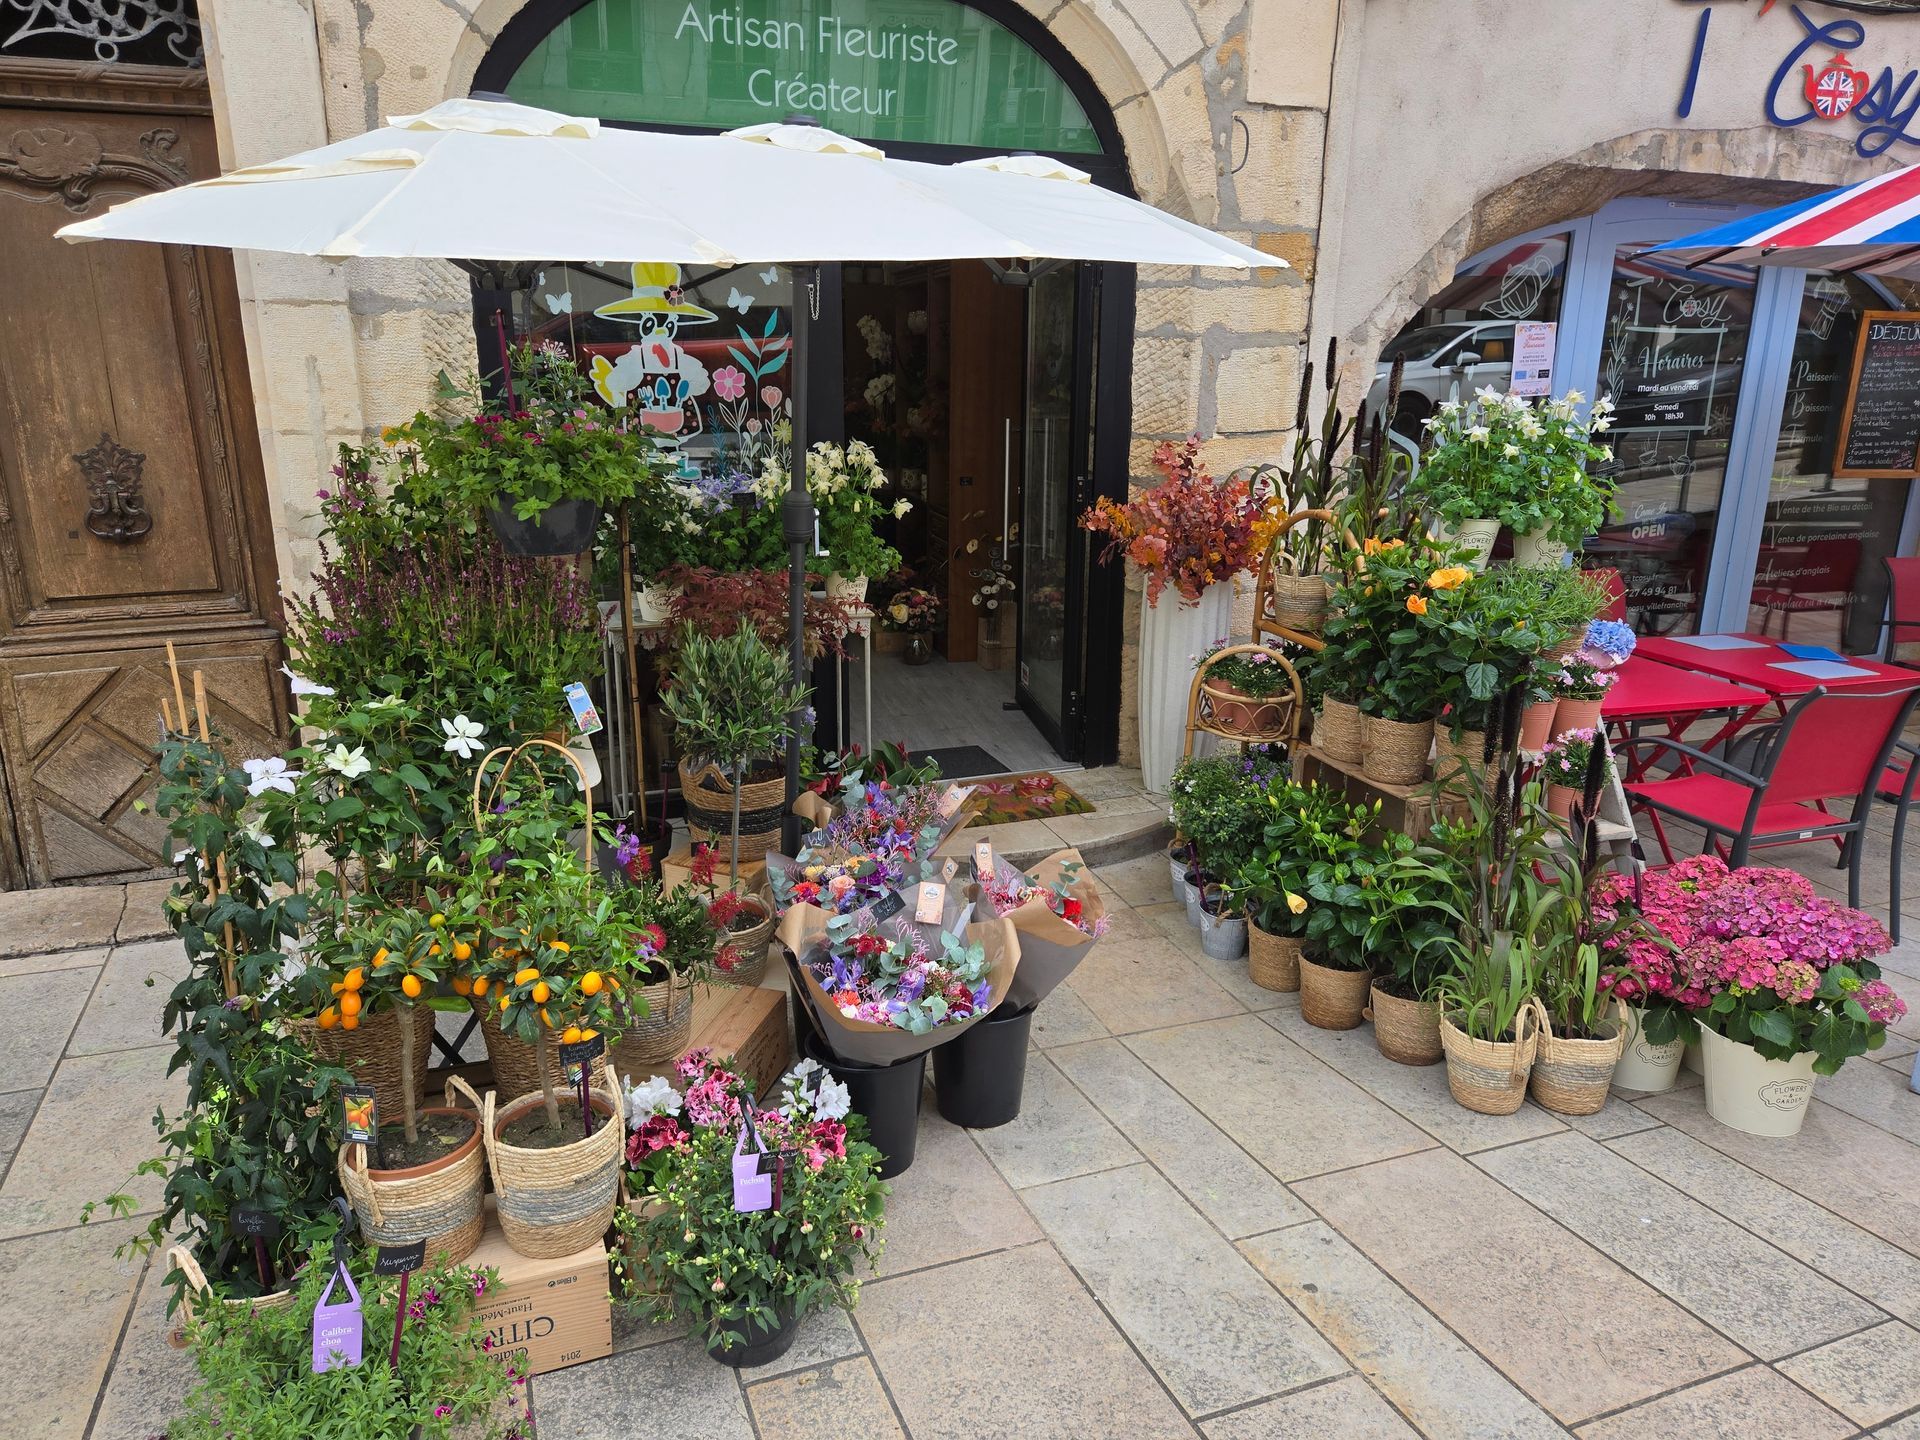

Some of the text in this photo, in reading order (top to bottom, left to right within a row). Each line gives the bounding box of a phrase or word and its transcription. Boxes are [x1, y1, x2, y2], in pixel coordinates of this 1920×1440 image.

[674, 1, 960, 66] Artisan Fleuriste
[748, 68, 898, 117] Créateur
[1637, 345, 1705, 379] Horaires
[1637, 384, 1659, 393] Mardi
[1670, 382, 1699, 392] vendredi
[1654, 402, 1679, 411] Samedi
[1644, 412, 1684, 421] 10h 18h30
[1801, 504, 1811, 514] de
[1813, 503, 1826, 513] thé
[1841, 504, 1851, 512] au
[1632, 523, 1666, 540] OPEN
[1766, 523, 1796, 549] Vente
[1797, 534, 1806, 543] de
[1807, 530, 1847, 544] porcelaine
[1463, 537, 1492, 545] FLOWERS
[1628, 586, 1678, 598] 27 49 94 81
[1774, 1085, 1808, 1095] FLOWERS
[469, 1302, 533, 1323] Haut-Méd
[321, 1326, 356, 1337] Calibra-
[560, 1350, 582, 1362] 2014
